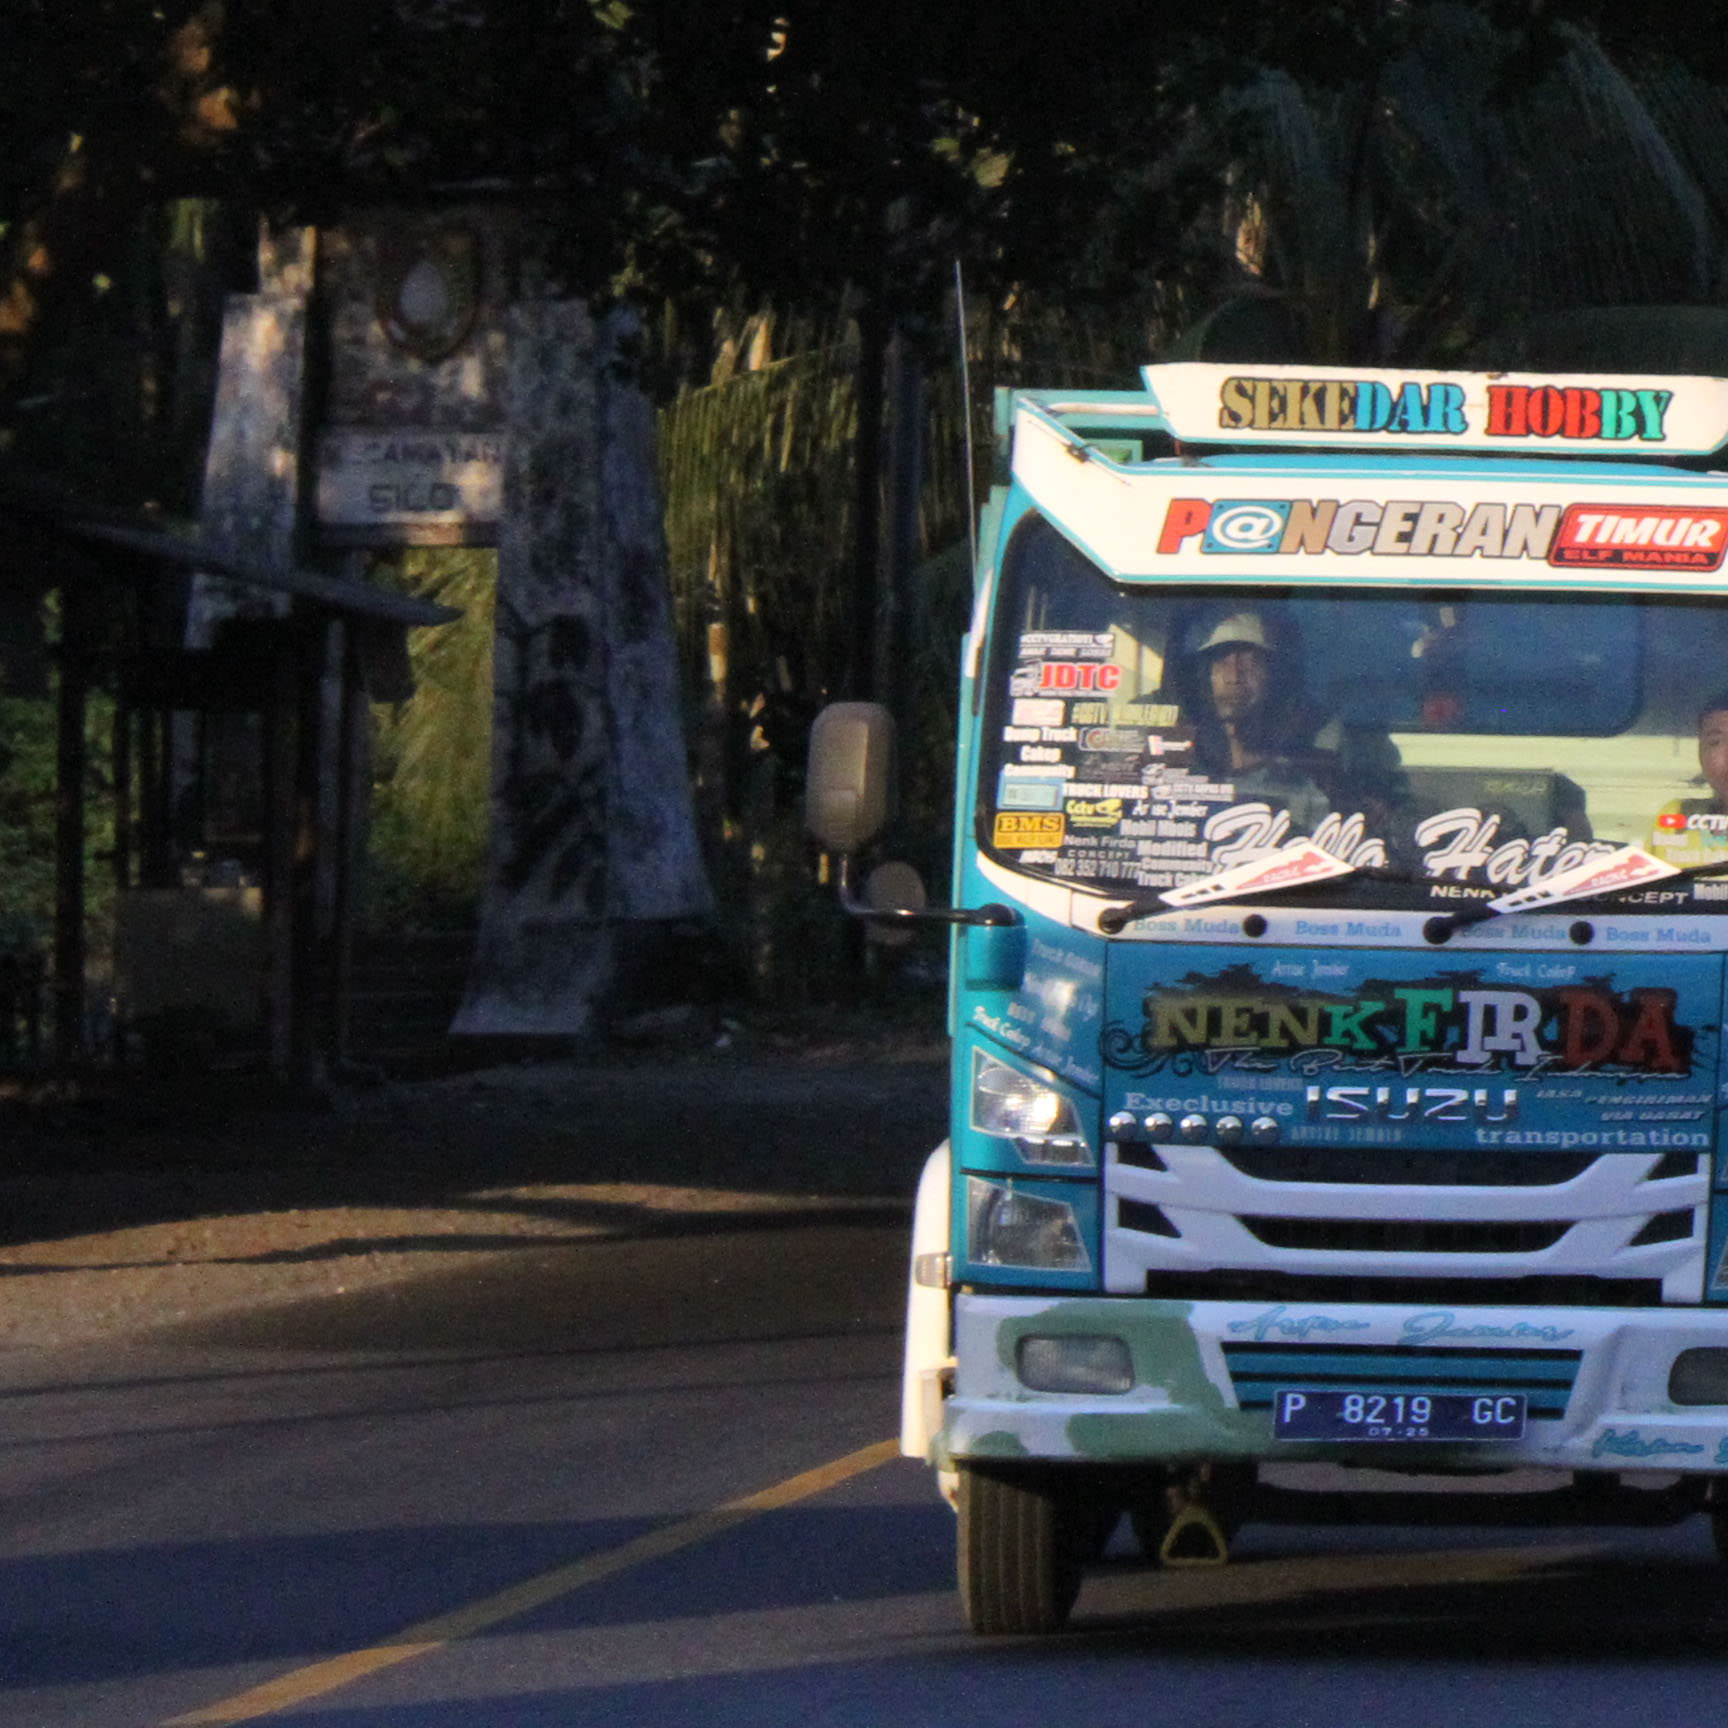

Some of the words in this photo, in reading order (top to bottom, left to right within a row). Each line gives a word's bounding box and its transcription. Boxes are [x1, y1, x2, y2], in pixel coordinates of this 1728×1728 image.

[1220, 376, 1467, 434] SEKEDAR
[1486, 384, 1673, 440] HOBBY
[1157, 498, 1560, 559] P@NGERAN
[1574, 514, 1722, 549] TIMUR
[1562, 549, 1615, 563] ELF
[1620, 551, 1708, 566] MANIA
[1039, 663, 1121, 690] JDTC
[999, 816, 1060, 832] BMS
[1295, 920, 1339, 936] Boss
[1345, 921, 1402, 937] Muda
[1510, 924, 1567, 941] Muda
[1606, 926, 1650, 942] Boss
[1655, 928, 1712, 944] Muda
[1149, 998, 1386, 1052] NENK
[1393, 986, 1690, 1070] FIRDA
[1205, 1046, 1278, 1073] The
[1124, 1092, 1294, 1117] Execlusive
[1306, 1087, 1518, 1122] ISUZU
[1475, 1128, 1711, 1148] transportation
[1284, 1392, 1307, 1423] P
[1343, 1393, 1432, 1424] 8219
[1472, 1396, 1517, 1425] GC
